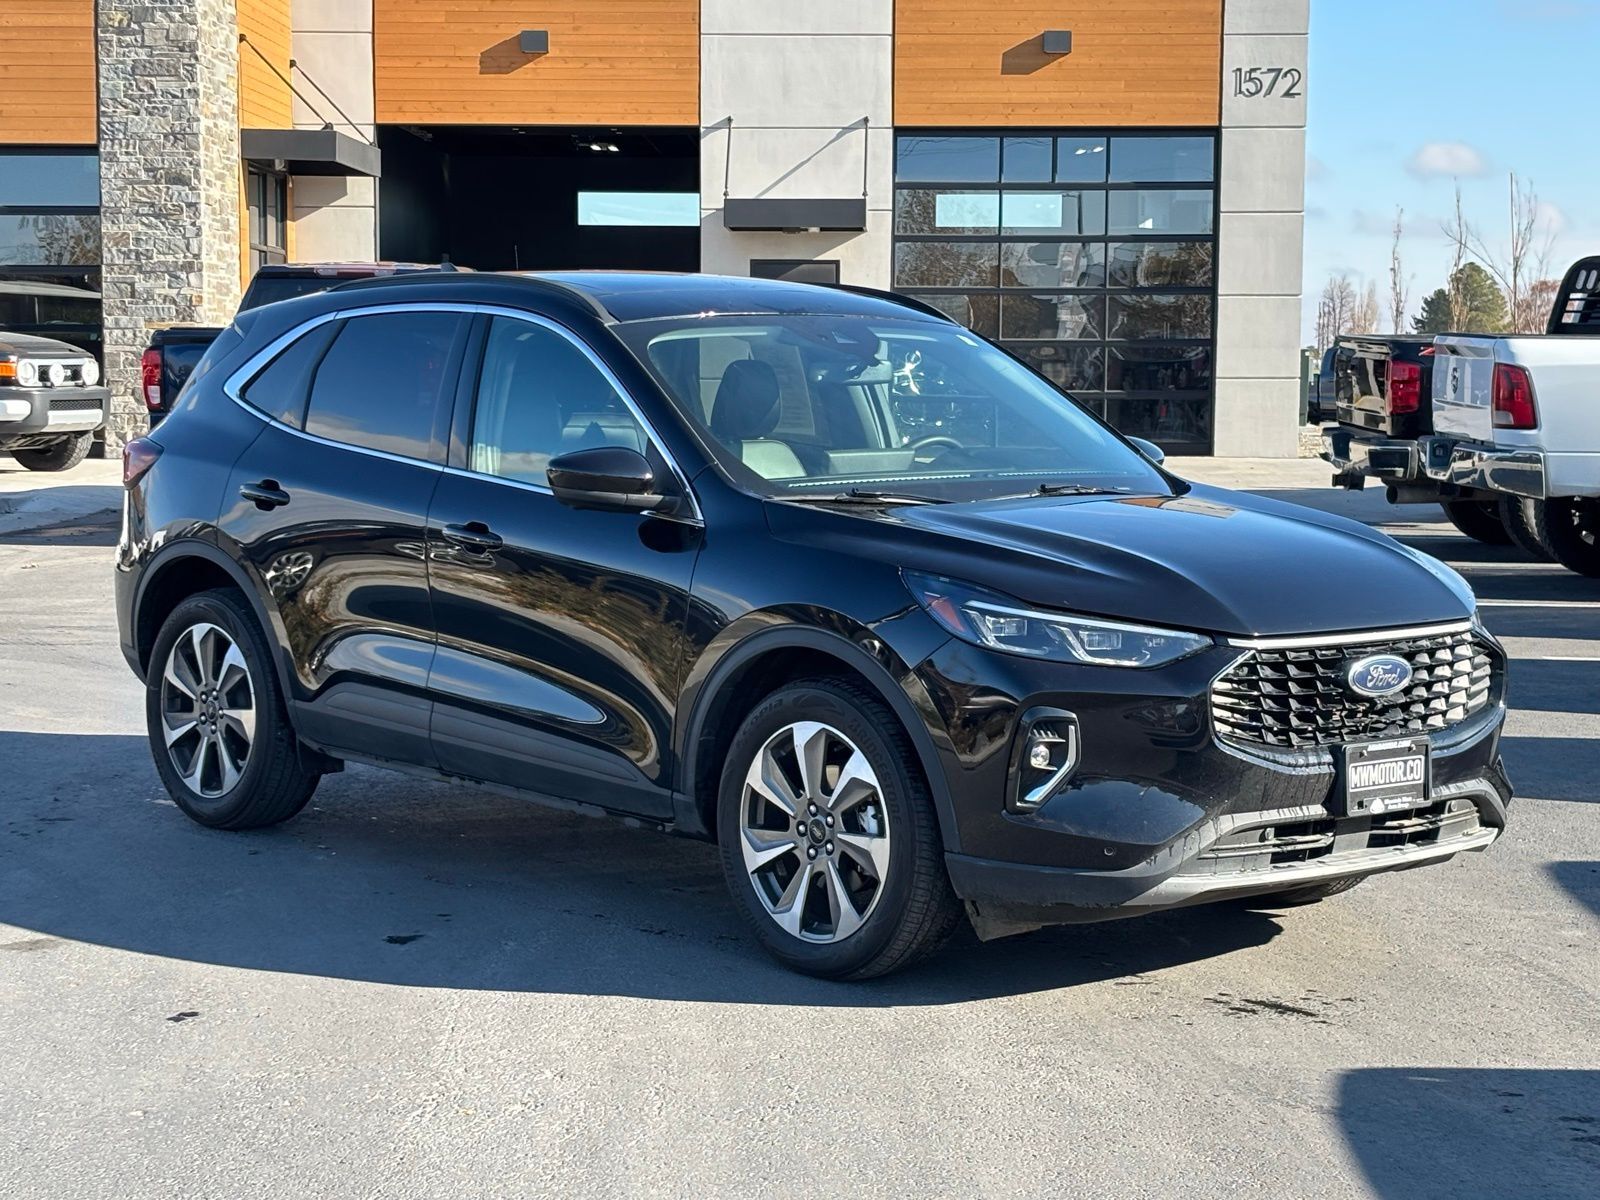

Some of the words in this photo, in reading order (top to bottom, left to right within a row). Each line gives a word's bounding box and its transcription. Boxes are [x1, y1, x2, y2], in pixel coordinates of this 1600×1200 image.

[1232, 67, 1302, 98] 1572
[1366, 664, 1400, 688] Ford
[1351, 759, 1421, 788] MWMOTOR.CO
